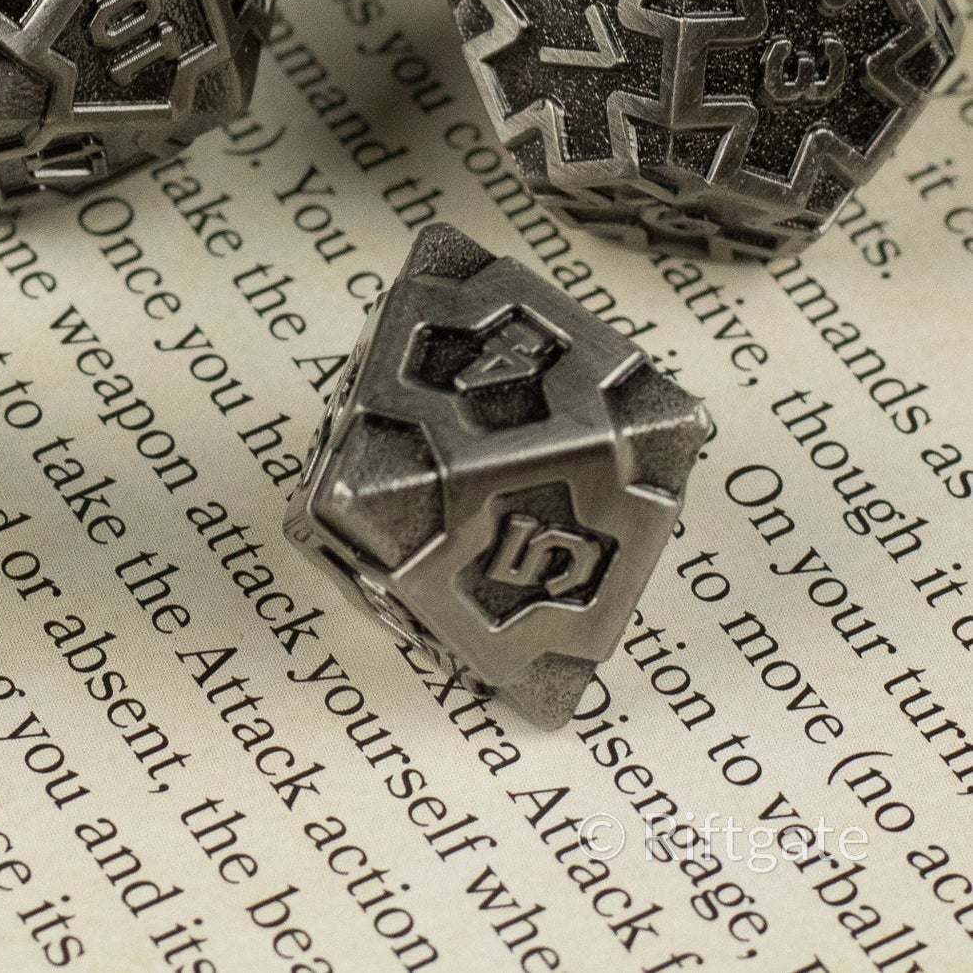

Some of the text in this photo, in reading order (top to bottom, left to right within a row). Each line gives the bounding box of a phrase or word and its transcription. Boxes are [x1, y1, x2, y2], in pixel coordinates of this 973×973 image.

[539, 2, 626, 68] 7
[761, 31, 846, 108] 3
[153, 149, 243, 257] take
[233, 264, 306, 341] the
[454, 324, 552, 392] 4
[275, 165, 356, 265] You
[708, 734, 762, 786] to
[484, 515, 602, 598] 5
[725, 465, 795, 546] On
[770, 546, 897, 658] your
[771, 390, 929, 563] though
[911, 563, 967, 608] it
[921, 444, 973, 498] as
[50, 304, 198, 494] weapon
[186, 502, 325, 655] attack
[287, 654, 497, 862] yourself
[77, 196, 181, 319] Once
[154, 325, 254, 416] you
[237, 413, 313, 502] ha
[506, 787, 663, 952] Attack
[1, 551, 61, 601] or
[44, 615, 191, 793] absent,
[181, 798, 258, 884] the
[33, 436, 126, 545] take
[115, 551, 191, 634] the
[175, 647, 325, 811] Attack
[304, 816, 438, 973] action
[677, 551, 730, 602] to
[719, 611, 843, 744] move
[827, 751, 915, 832] (no
[17, 895, 85, 967] its
[75, 818, 184, 917] and
